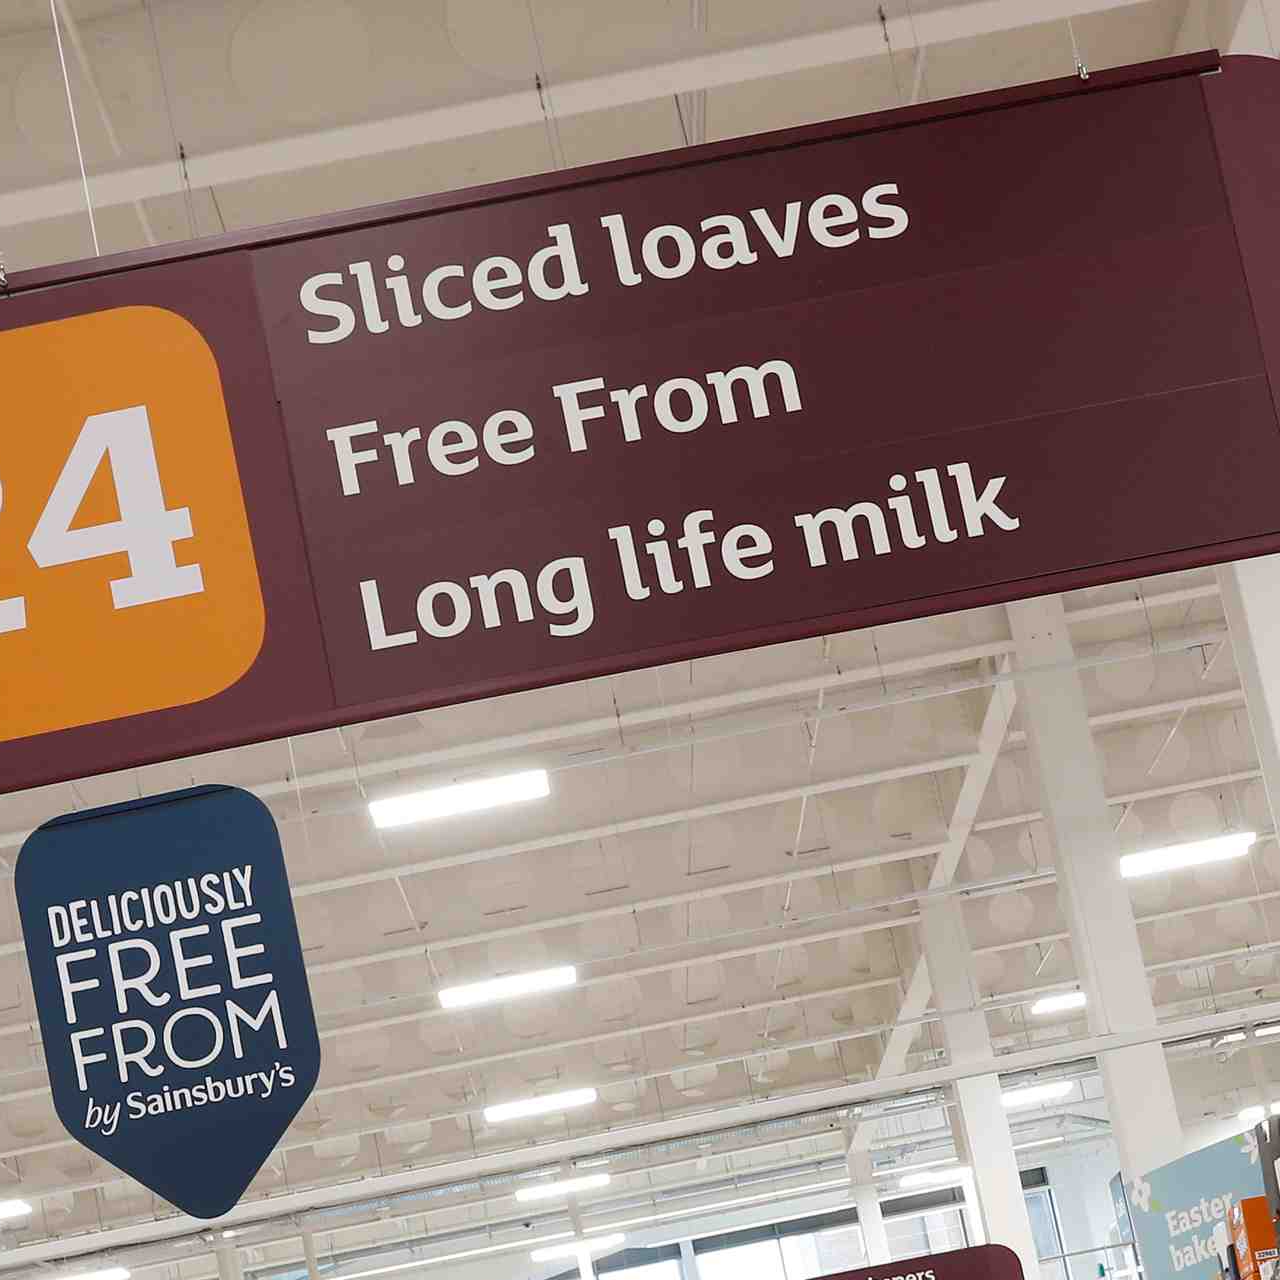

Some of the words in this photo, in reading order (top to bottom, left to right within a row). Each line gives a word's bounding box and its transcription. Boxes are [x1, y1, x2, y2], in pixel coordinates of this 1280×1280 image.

[299, 226, 589, 344] Sliced
[603, 180, 909, 288] loaves
[326, 405, 535, 496] Free
[554, 353, 803, 454] From
[358, 550, 594, 653] Long
[616, 518, 776, 604] life
[792, 462, 1019, 558] milk
[47, 865, 253, 947] DELICIOUSLY
[56, 914, 273, 1024] FREE
[70, 991, 287, 1091] FROM
[84, 1098, 122, 1135] by
[126, 1062, 296, 1120] Sainsbury's
[1167, 1191, 1233, 1236] Easter
